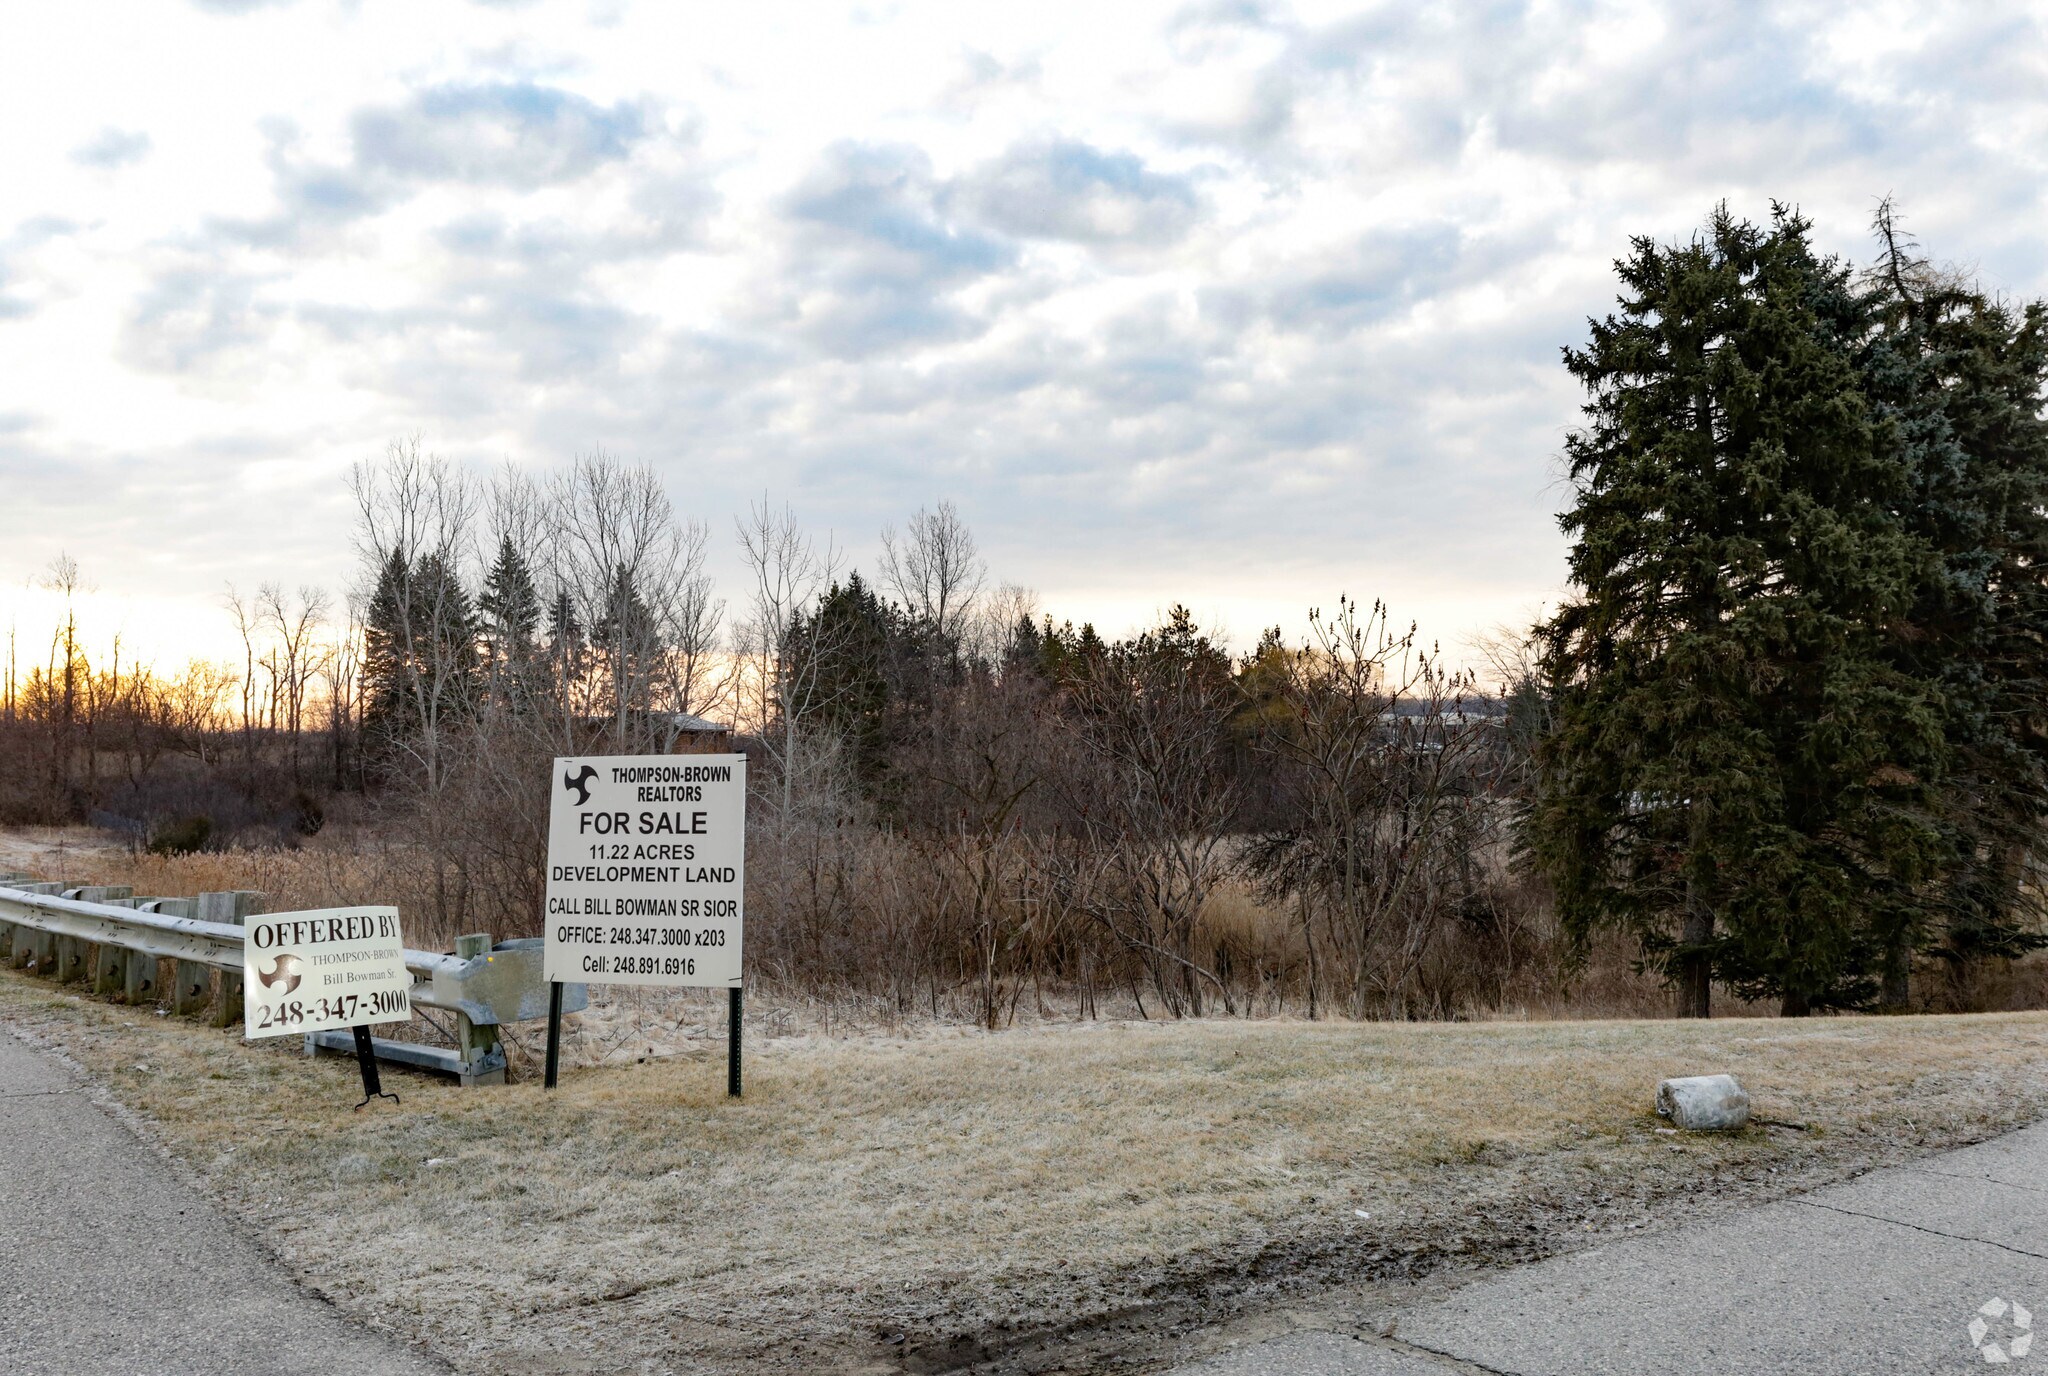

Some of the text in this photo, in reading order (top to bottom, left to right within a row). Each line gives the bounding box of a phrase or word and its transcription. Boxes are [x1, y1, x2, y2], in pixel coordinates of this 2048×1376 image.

[612, 766, 730, 783] THOMPSON-BROWN
[638, 786, 702, 802] REALTORS
[580, 812, 707, 834] FOR SALE
[590, 845, 694, 859] 11.22 ACRES
[553, 867, 735, 882] DEVELOPMENT LAND
[549, 898, 737, 917] CALL BILL BOWMAN SR SIOR
[254, 916, 396, 948] OFFERED BY
[558, 927, 725, 946] OFFICE: 248.347.3000 x203
[311, 949, 398, 965] THOMPSON-BROWN
[583, 956, 695, 975] Cell: 248.891.6916
[323, 973, 343, 985] Bill
[347, 970, 385, 982] Bowman
[257, 990, 406, 1029] 248-347-3000
